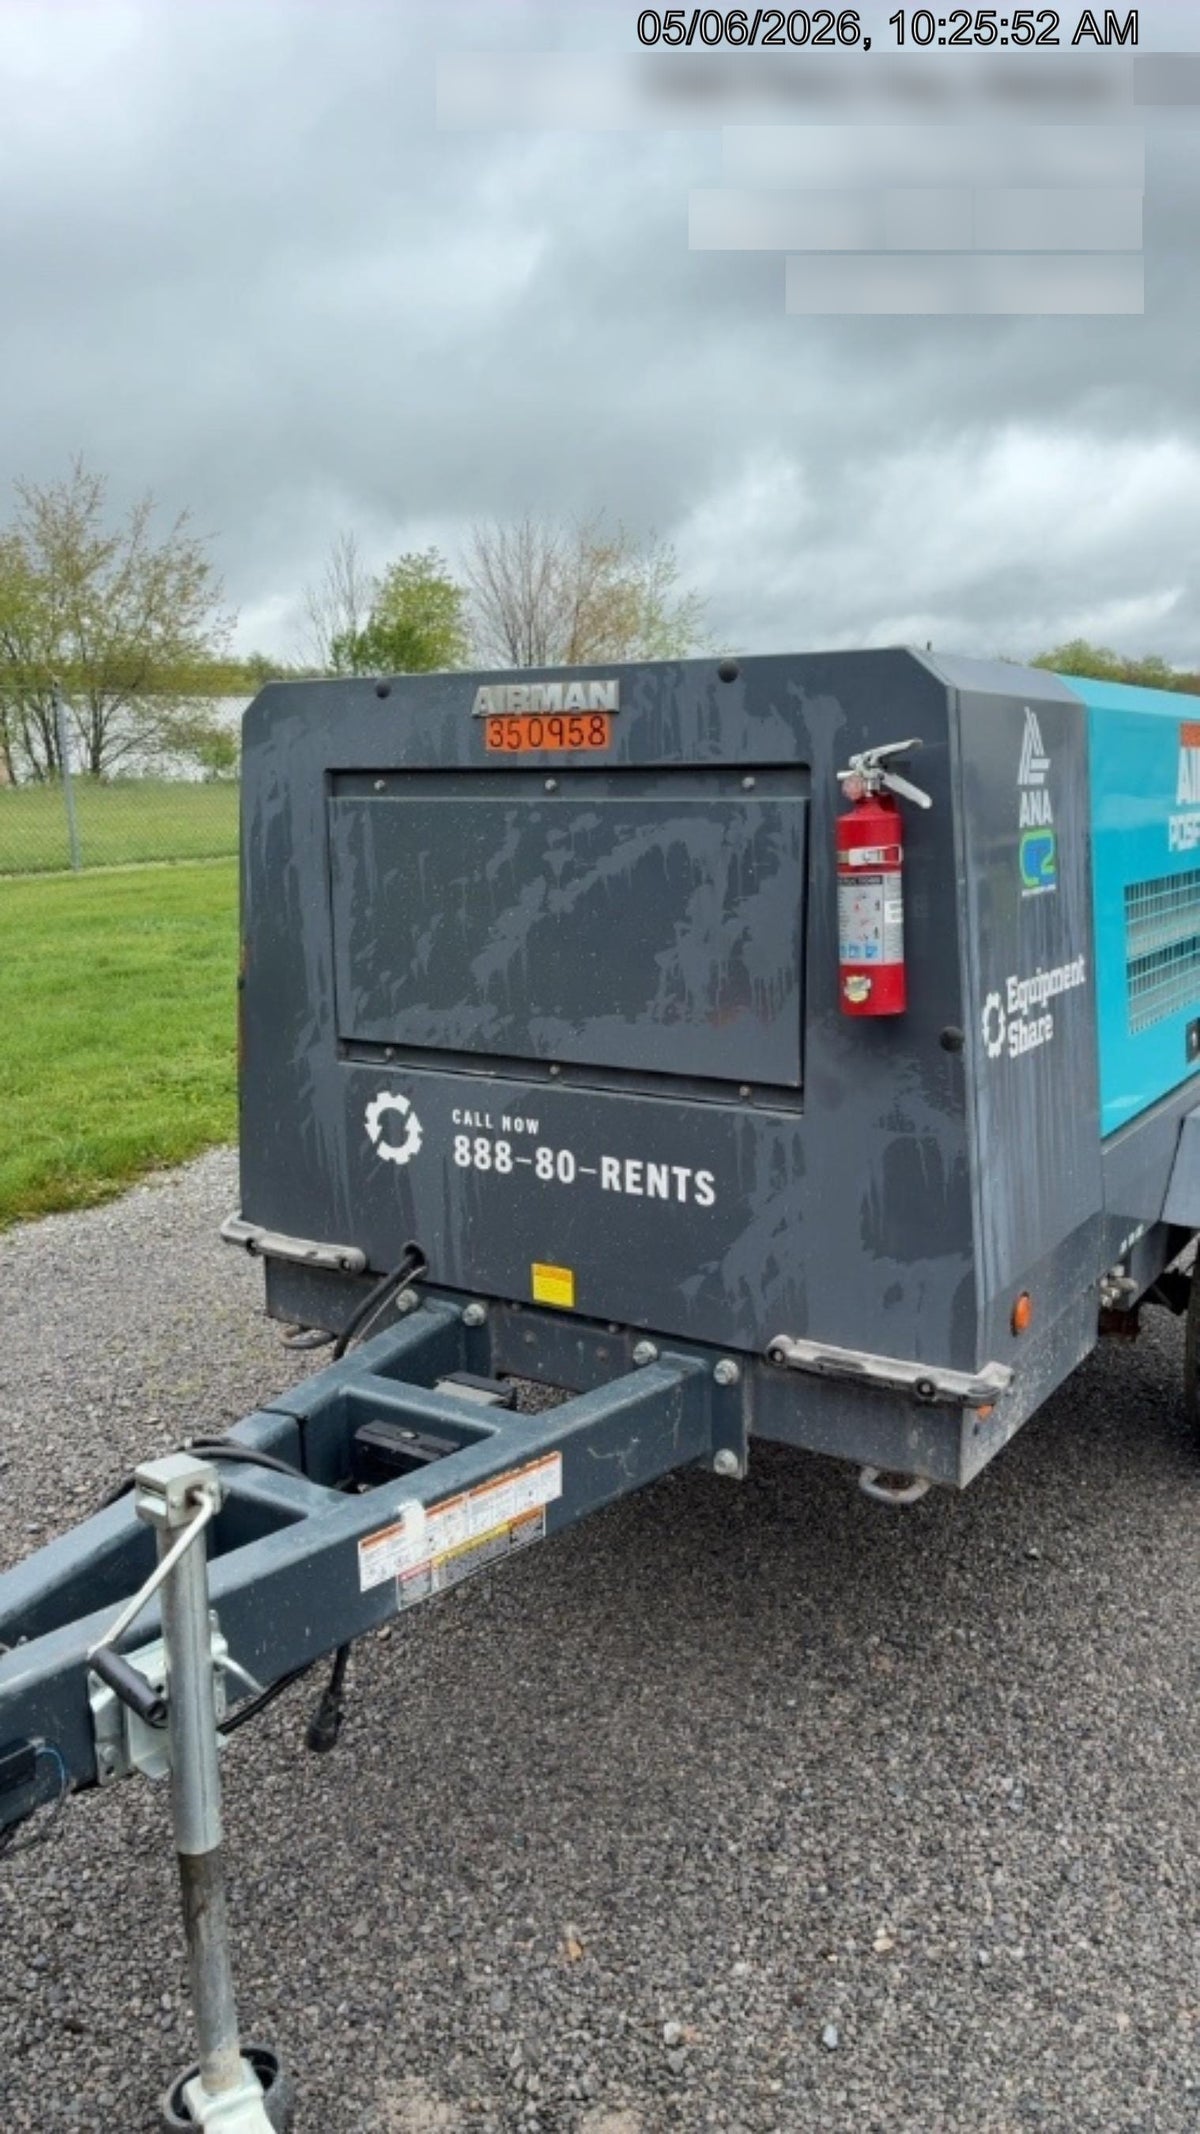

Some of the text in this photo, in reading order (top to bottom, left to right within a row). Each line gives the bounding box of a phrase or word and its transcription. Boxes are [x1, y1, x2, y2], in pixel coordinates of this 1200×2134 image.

[473, 680, 620, 716] AIRMAN
[489, 715, 606, 750] 350958
[1176, 747, 1200, 806] AI
[1019, 789, 1053, 828] ANA
[1006, 954, 1086, 1016] Equipment
[1007, 1014, 1054, 1059] Share
[452, 1109, 540, 1136] CALL NOW
[453, 1135, 717, 1208] 888-80-RENTS
